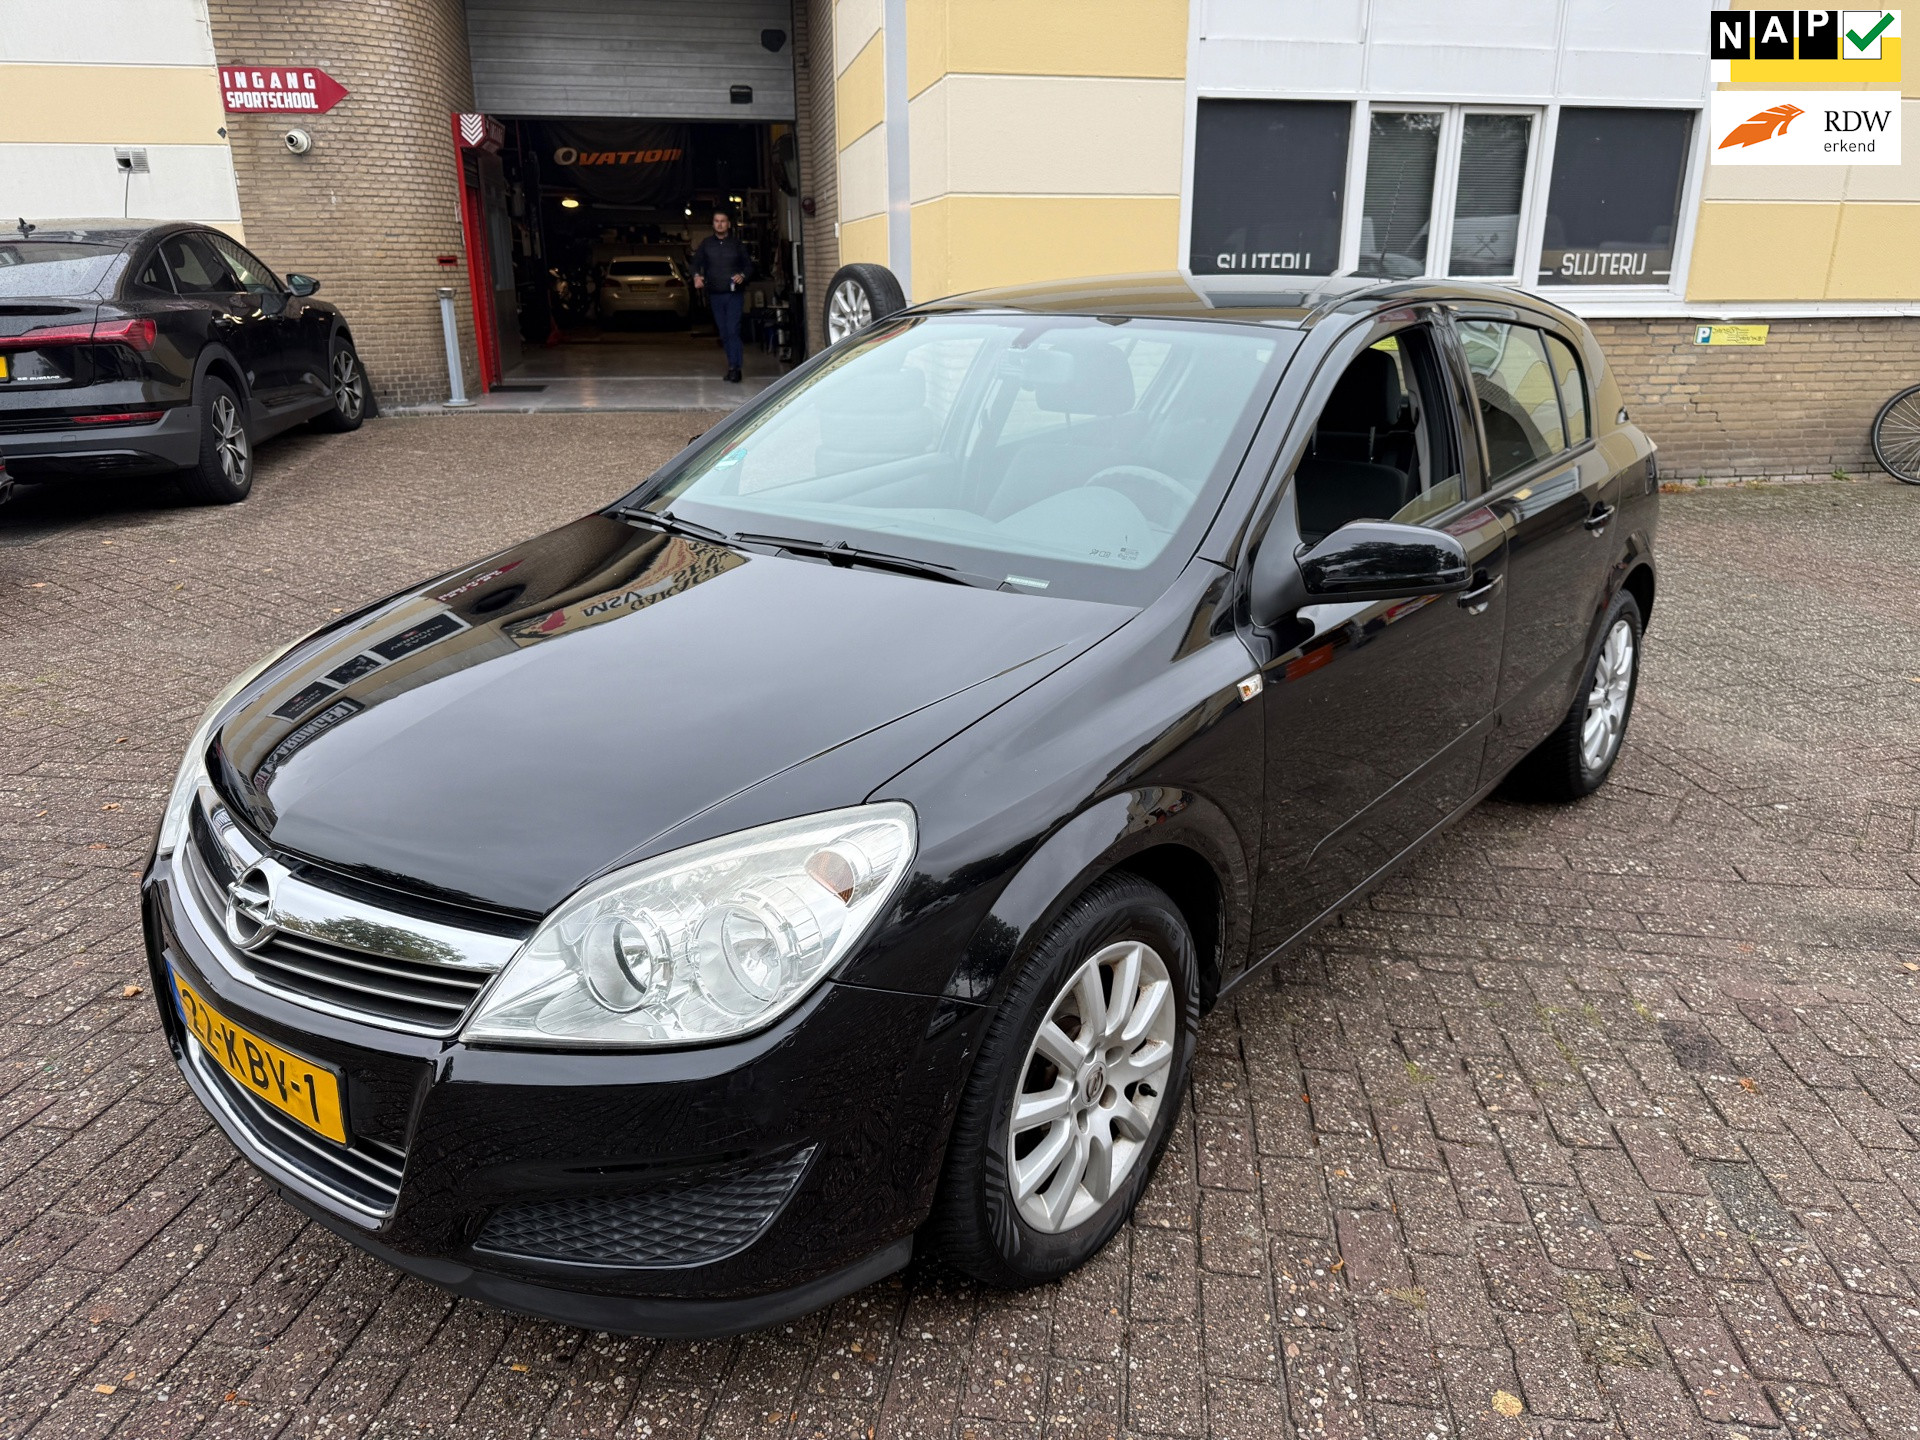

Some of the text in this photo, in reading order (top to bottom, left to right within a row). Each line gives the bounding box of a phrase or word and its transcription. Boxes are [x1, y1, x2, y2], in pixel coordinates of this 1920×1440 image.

[223, 72, 316, 89] INGANG
[227, 92, 318, 109] SPORTSCHOOL
[553, 147, 682, 166] OVATION
[1561, 253, 1647, 275] SLIJTERIJ
[181, 988, 321, 1124] 22-KBV-1
